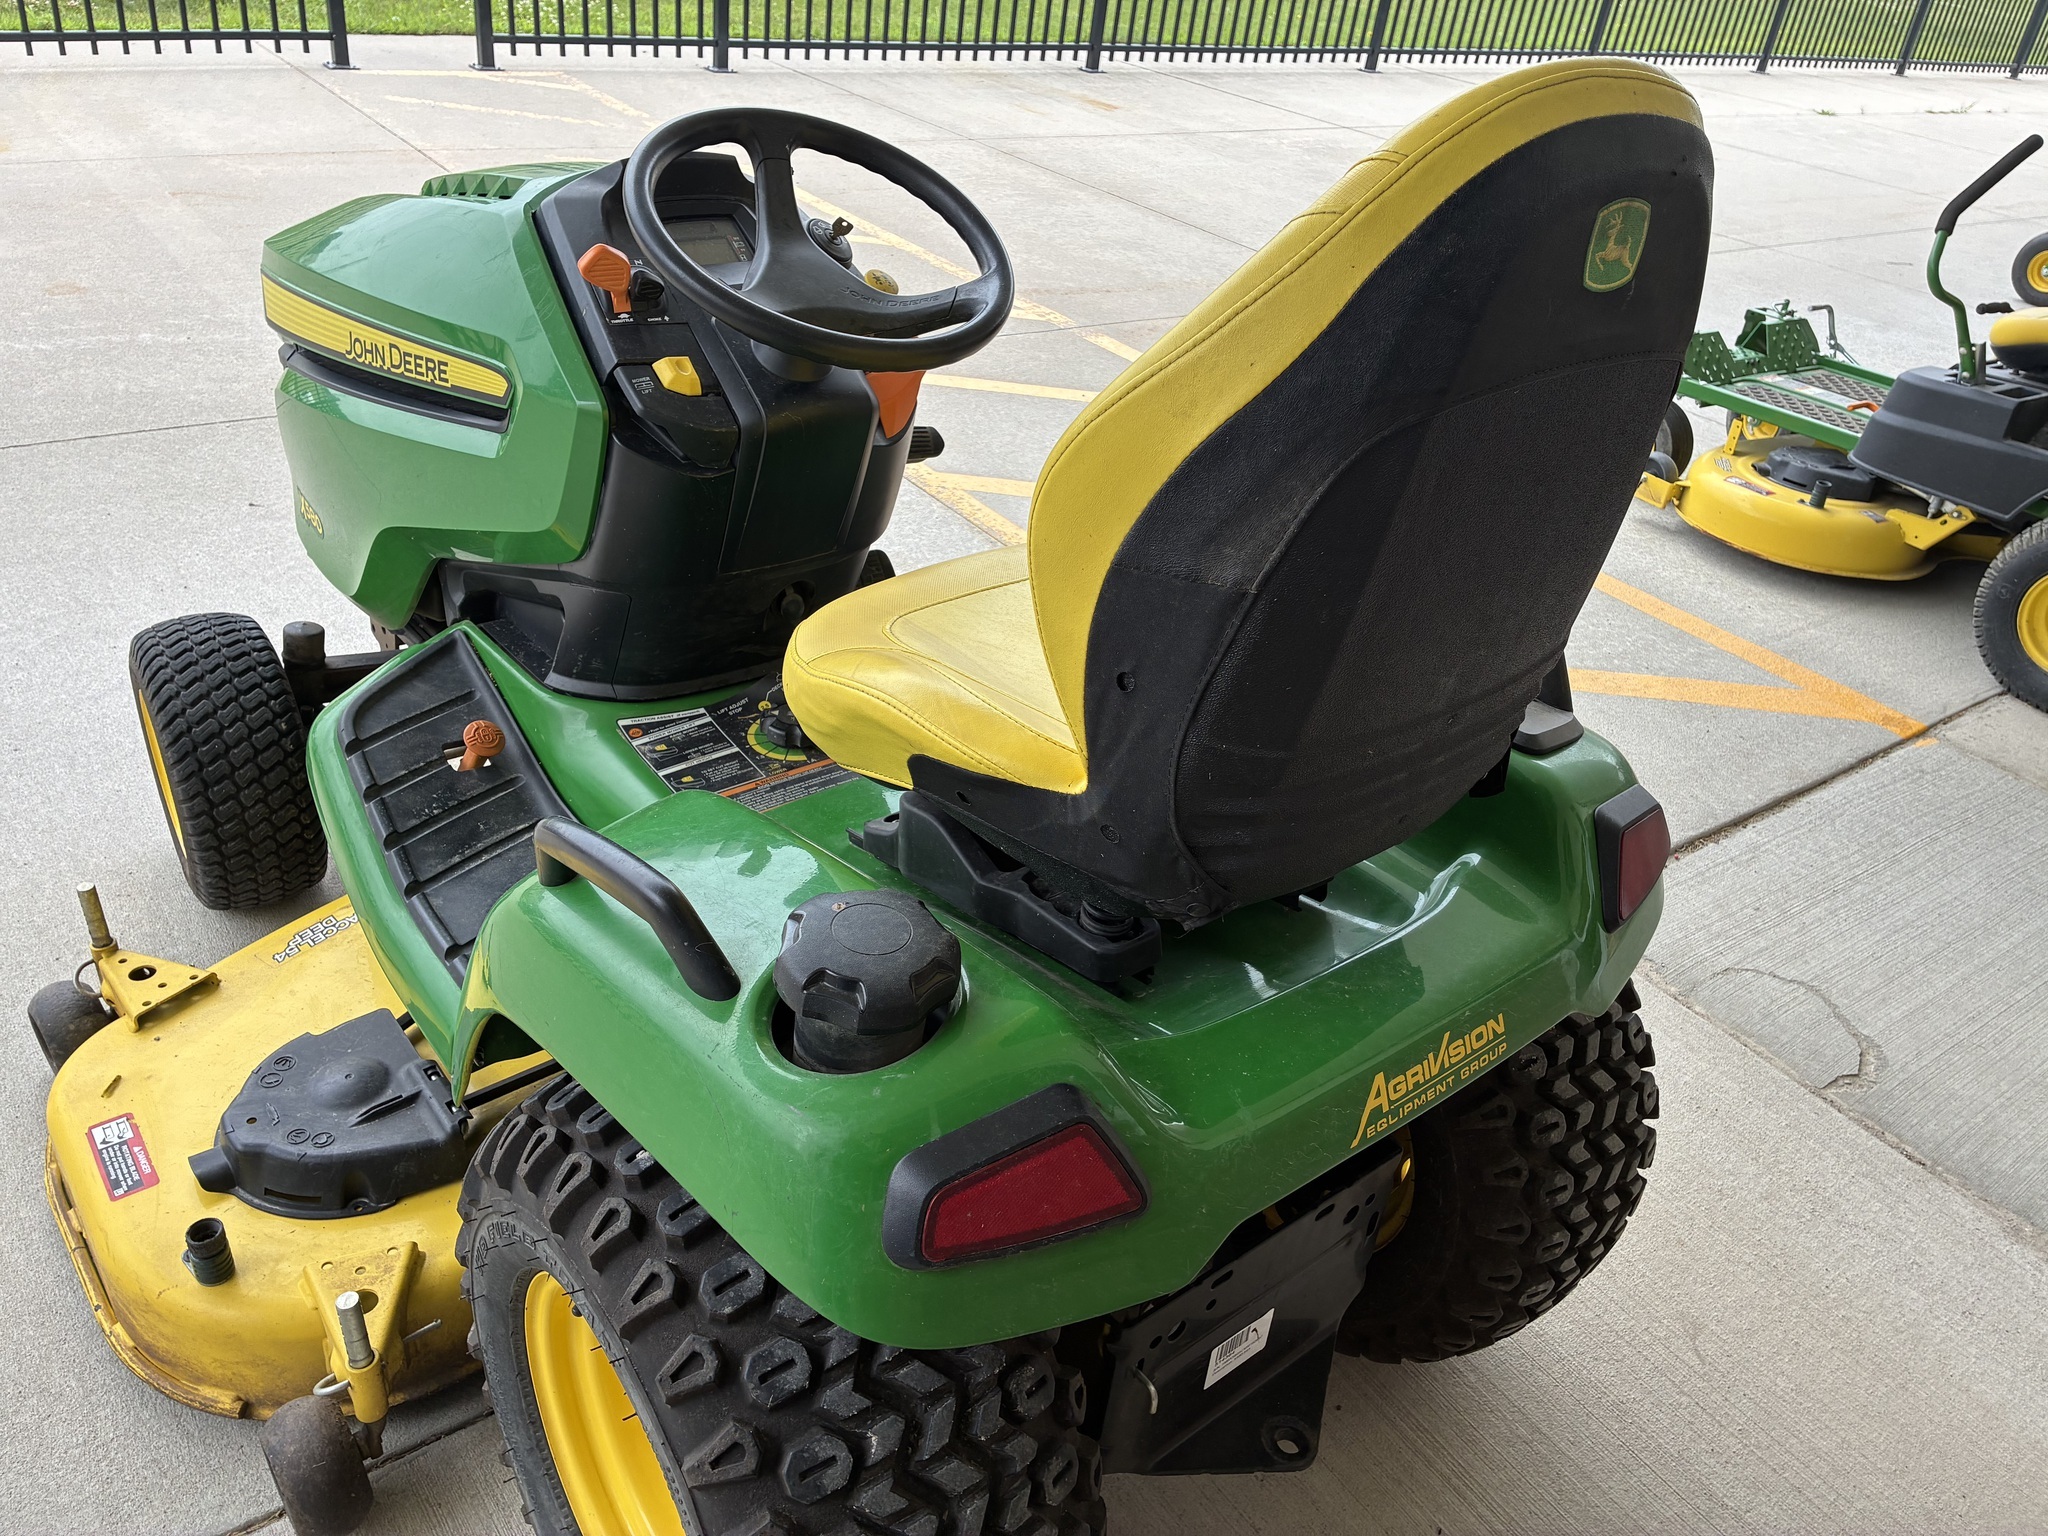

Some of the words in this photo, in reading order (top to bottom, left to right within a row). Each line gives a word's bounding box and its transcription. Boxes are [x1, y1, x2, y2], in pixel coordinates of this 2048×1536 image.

[840, 286, 883, 306] JOHN
[885, 294, 940, 307] DEERE
[345, 331, 386, 370] JOHN
[388, 342, 451, 388] DEERE
[717, 707, 728, 715] LIFT
[729, 697, 749, 710] ADJUST
[728, 707, 743, 716] STOP
[288, 915, 338, 947] DEEP
[300, 913, 359, 948] ACCEL
[272, 945, 301, 964] 54
[1460, 1042, 1508, 1080] GROUP
[136, 1149, 152, 1175] DANGER
